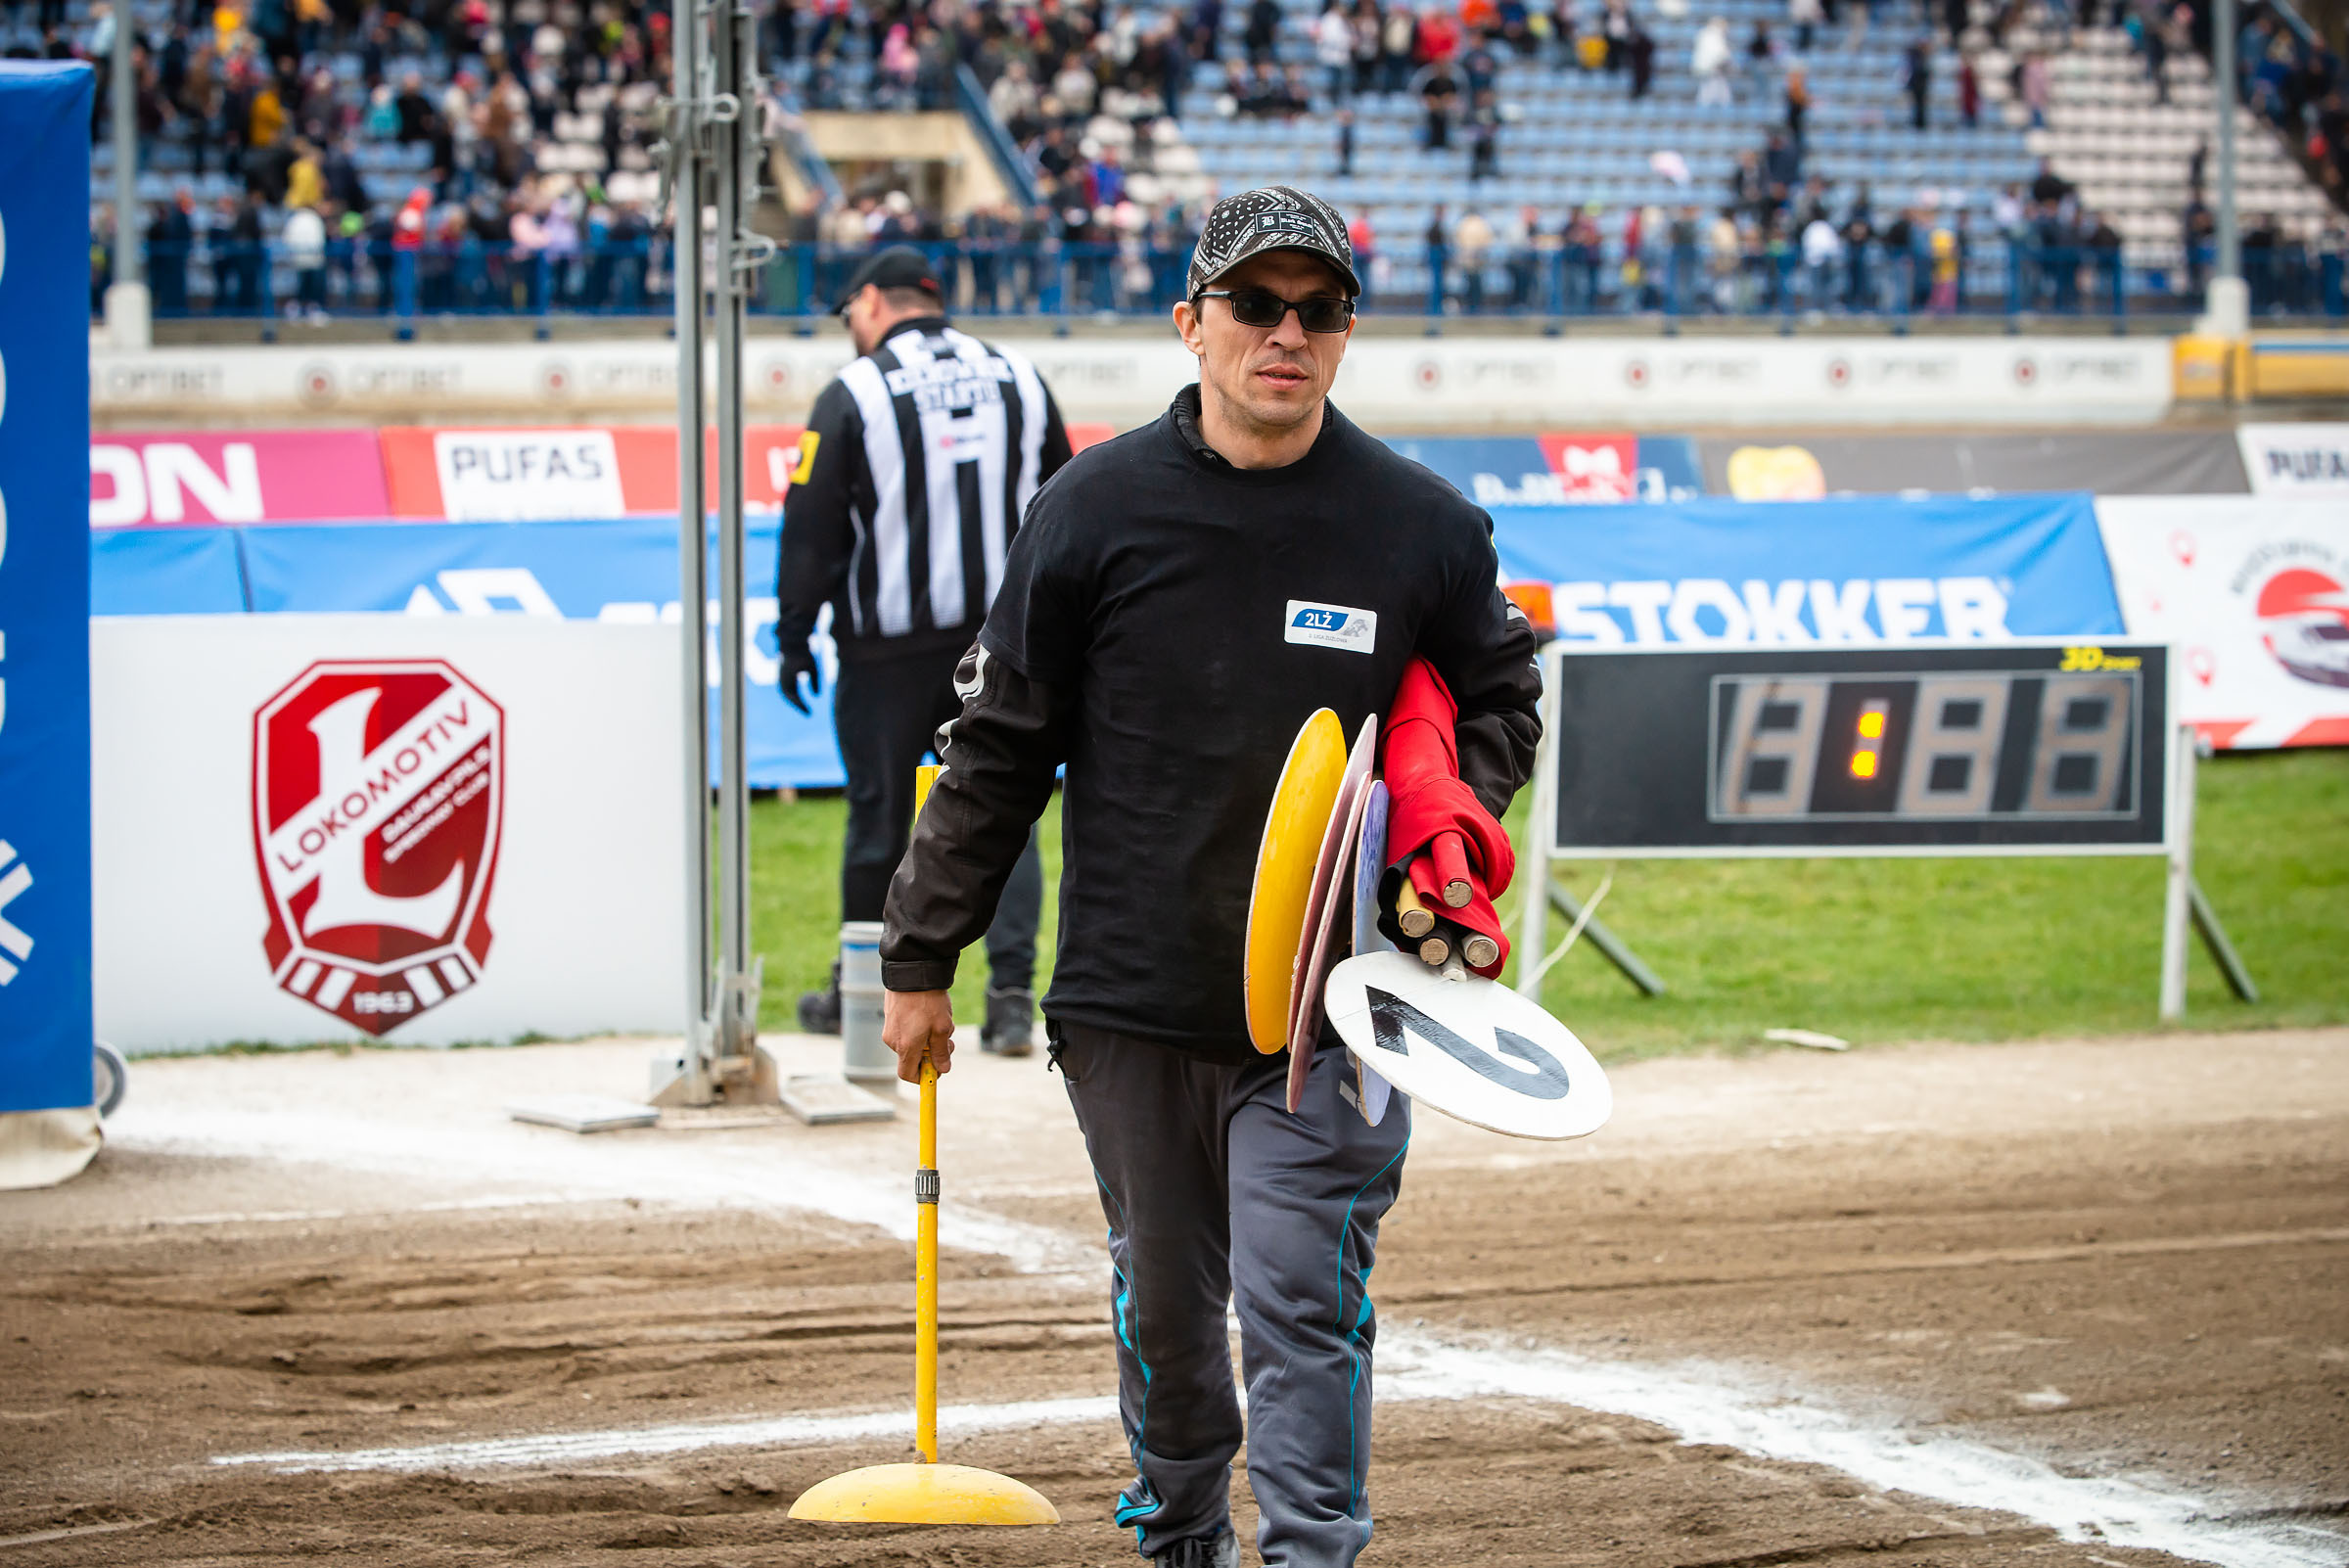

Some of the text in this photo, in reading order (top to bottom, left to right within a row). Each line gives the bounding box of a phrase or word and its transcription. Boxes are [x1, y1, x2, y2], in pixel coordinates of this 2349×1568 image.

[450, 445, 605, 483] PUFAS
[1305, 612, 1333, 628] 2LŻ
[1554, 576, 2014, 642] STOKKER
[278, 699, 470, 872] LOKOMOTIV
[353, 991, 414, 1014] 1963
[1366, 985, 1569, 1099] 2
